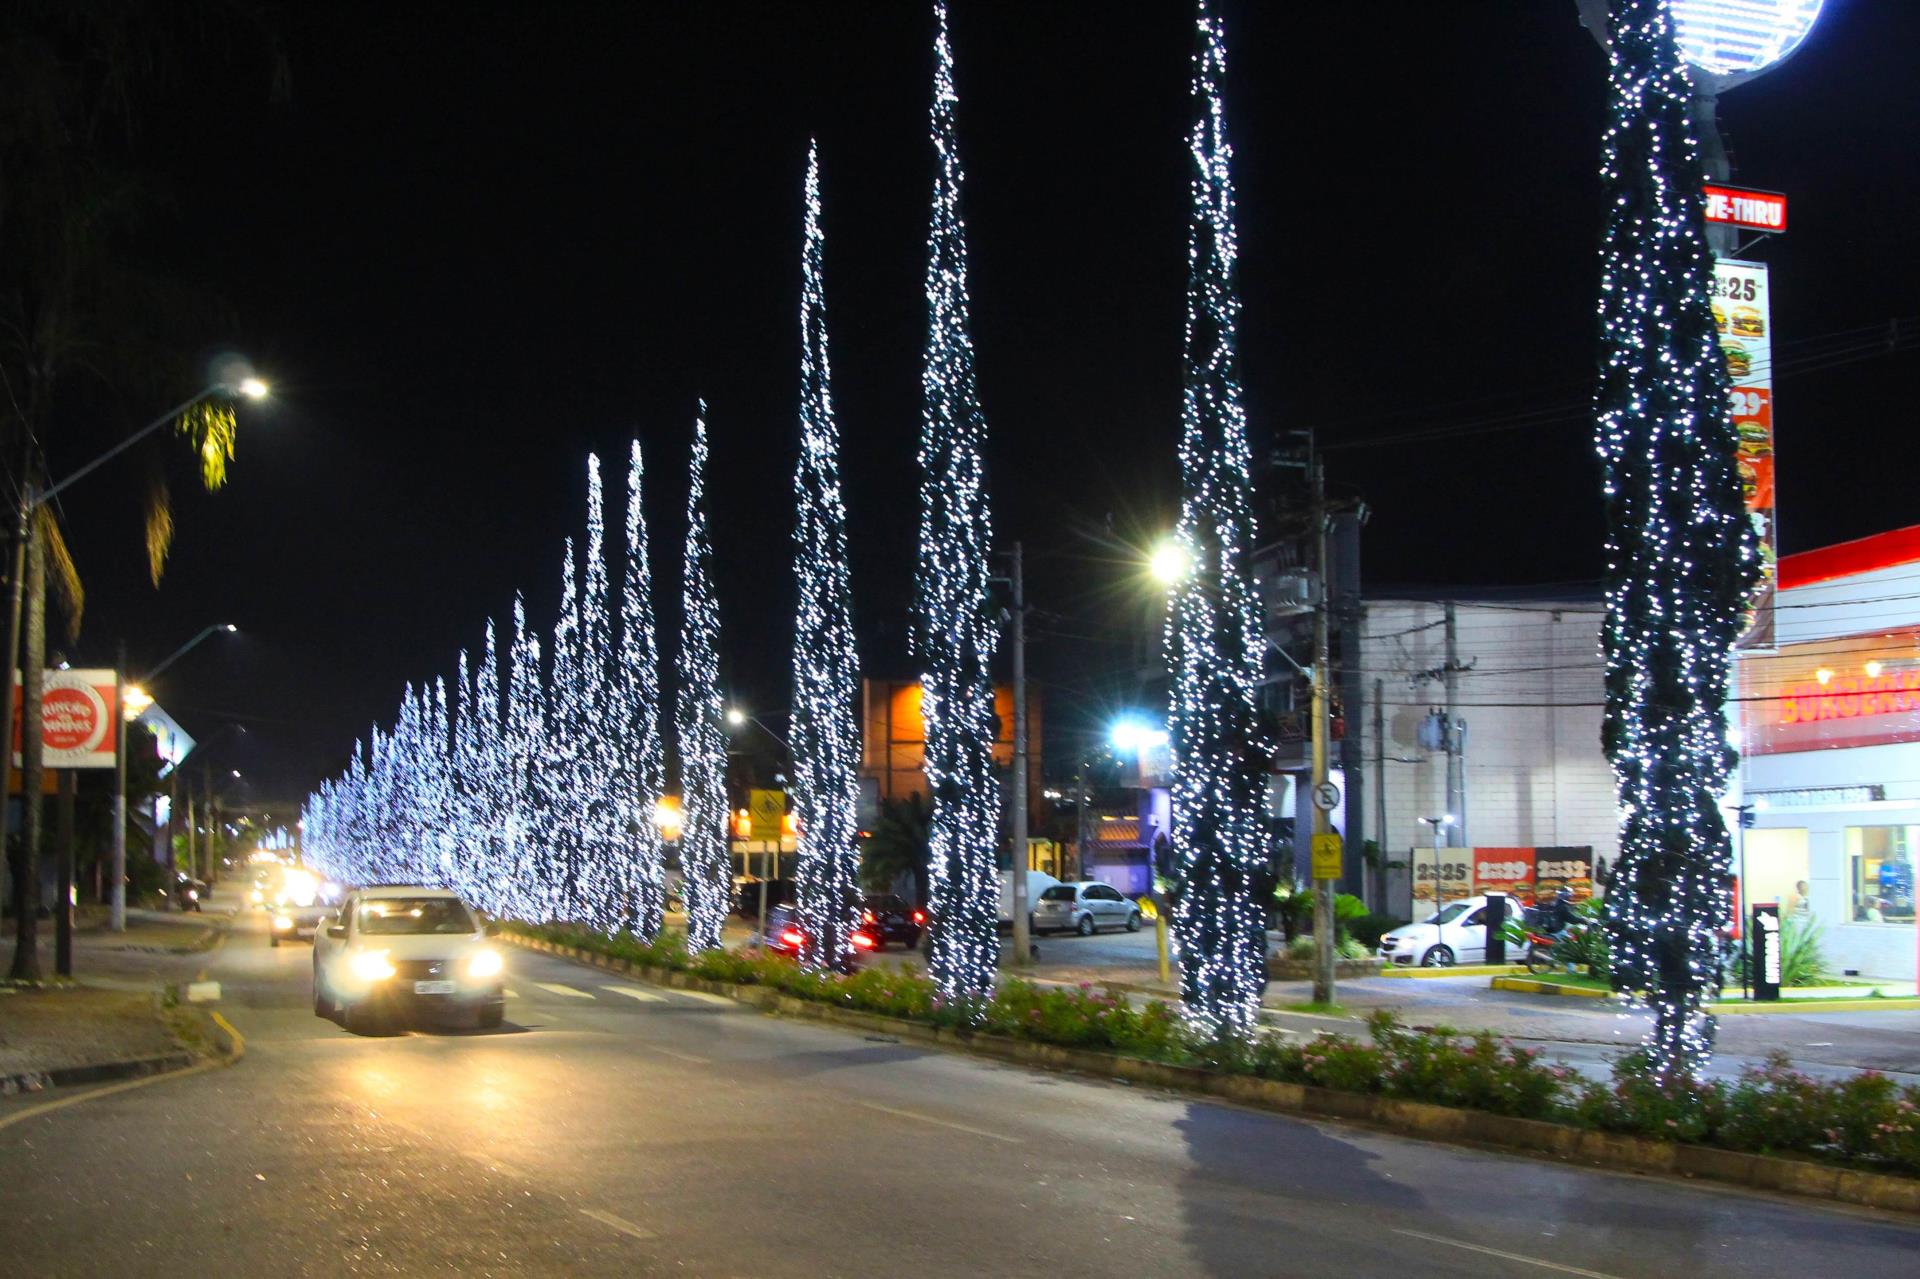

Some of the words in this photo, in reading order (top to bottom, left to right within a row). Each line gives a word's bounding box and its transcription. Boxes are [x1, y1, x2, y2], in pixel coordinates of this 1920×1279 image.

[1728, 277, 1756, 302] 25
[1729, 391, 1761, 416] 29
[1780, 671, 1898, 723] BURGER
